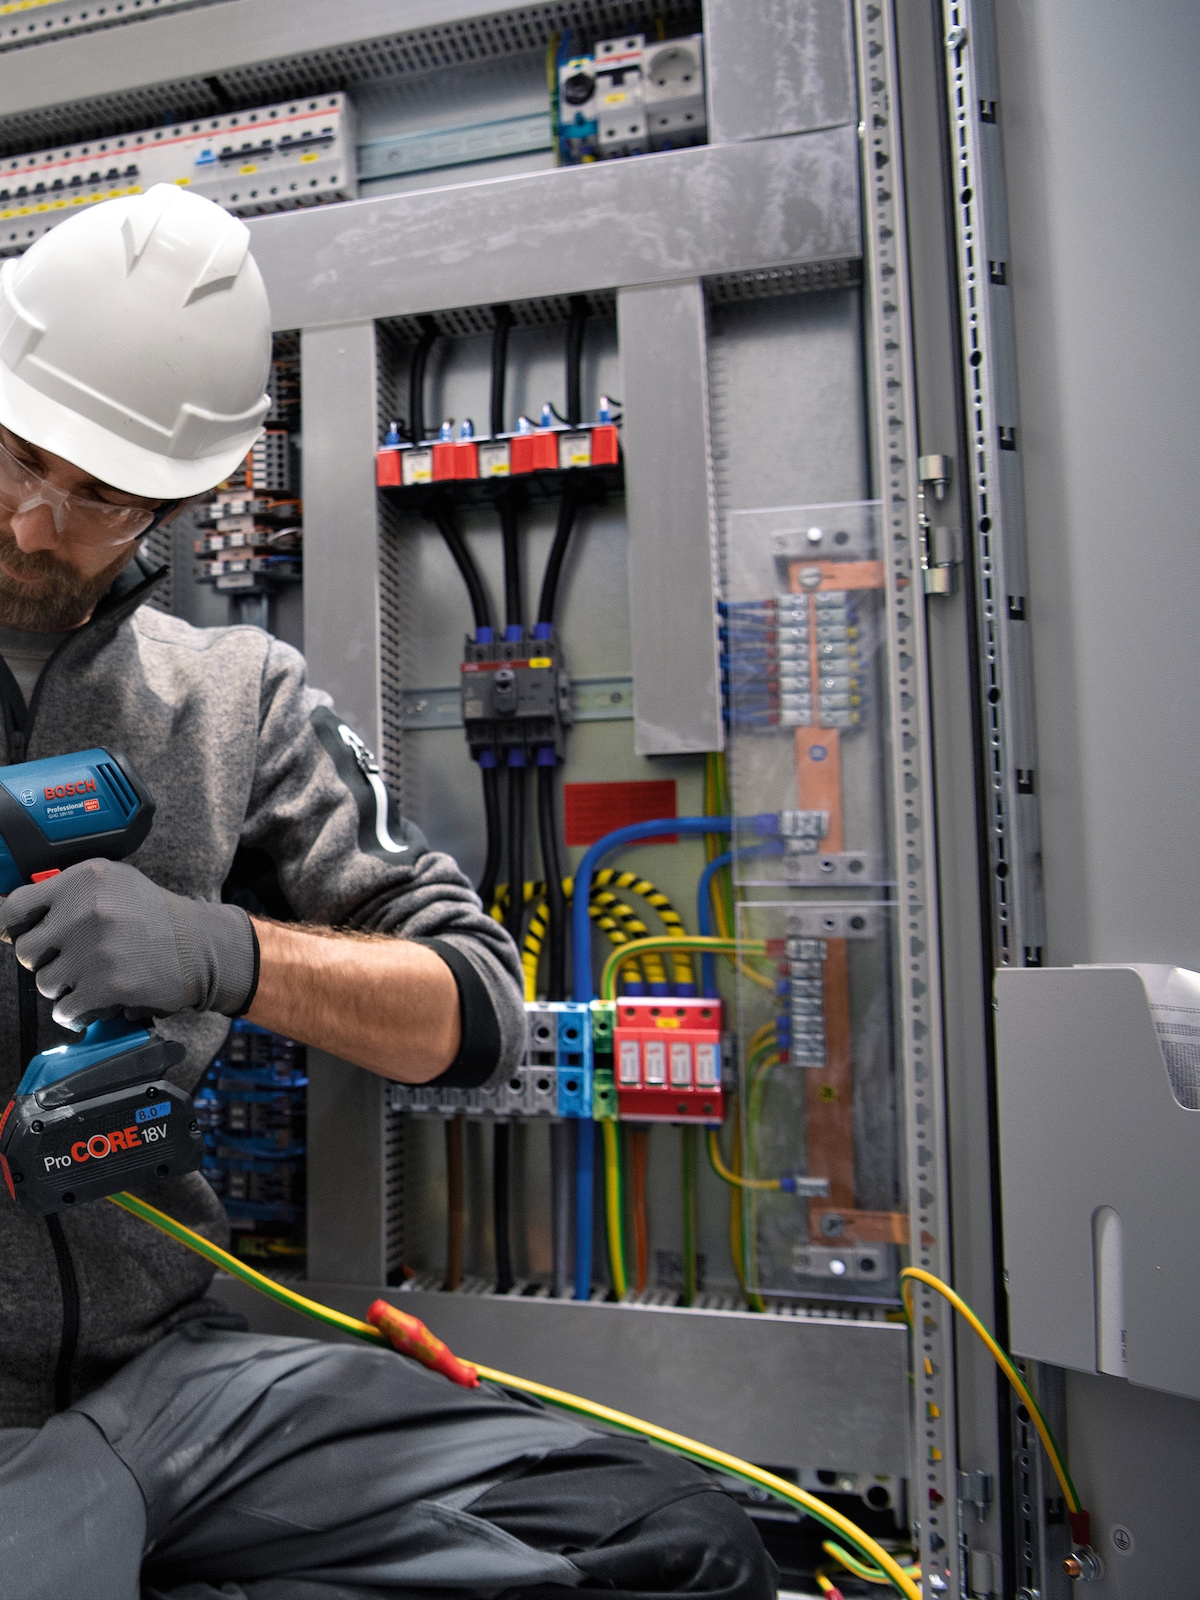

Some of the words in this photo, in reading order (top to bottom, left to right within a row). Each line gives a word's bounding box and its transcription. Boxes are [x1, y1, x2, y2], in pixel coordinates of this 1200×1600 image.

[43, 778, 97, 800] BOSCH
[47, 802, 84, 814] Professional
[138, 1107, 157, 1120] 8.0
[141, 1123, 167, 1143] 18V
